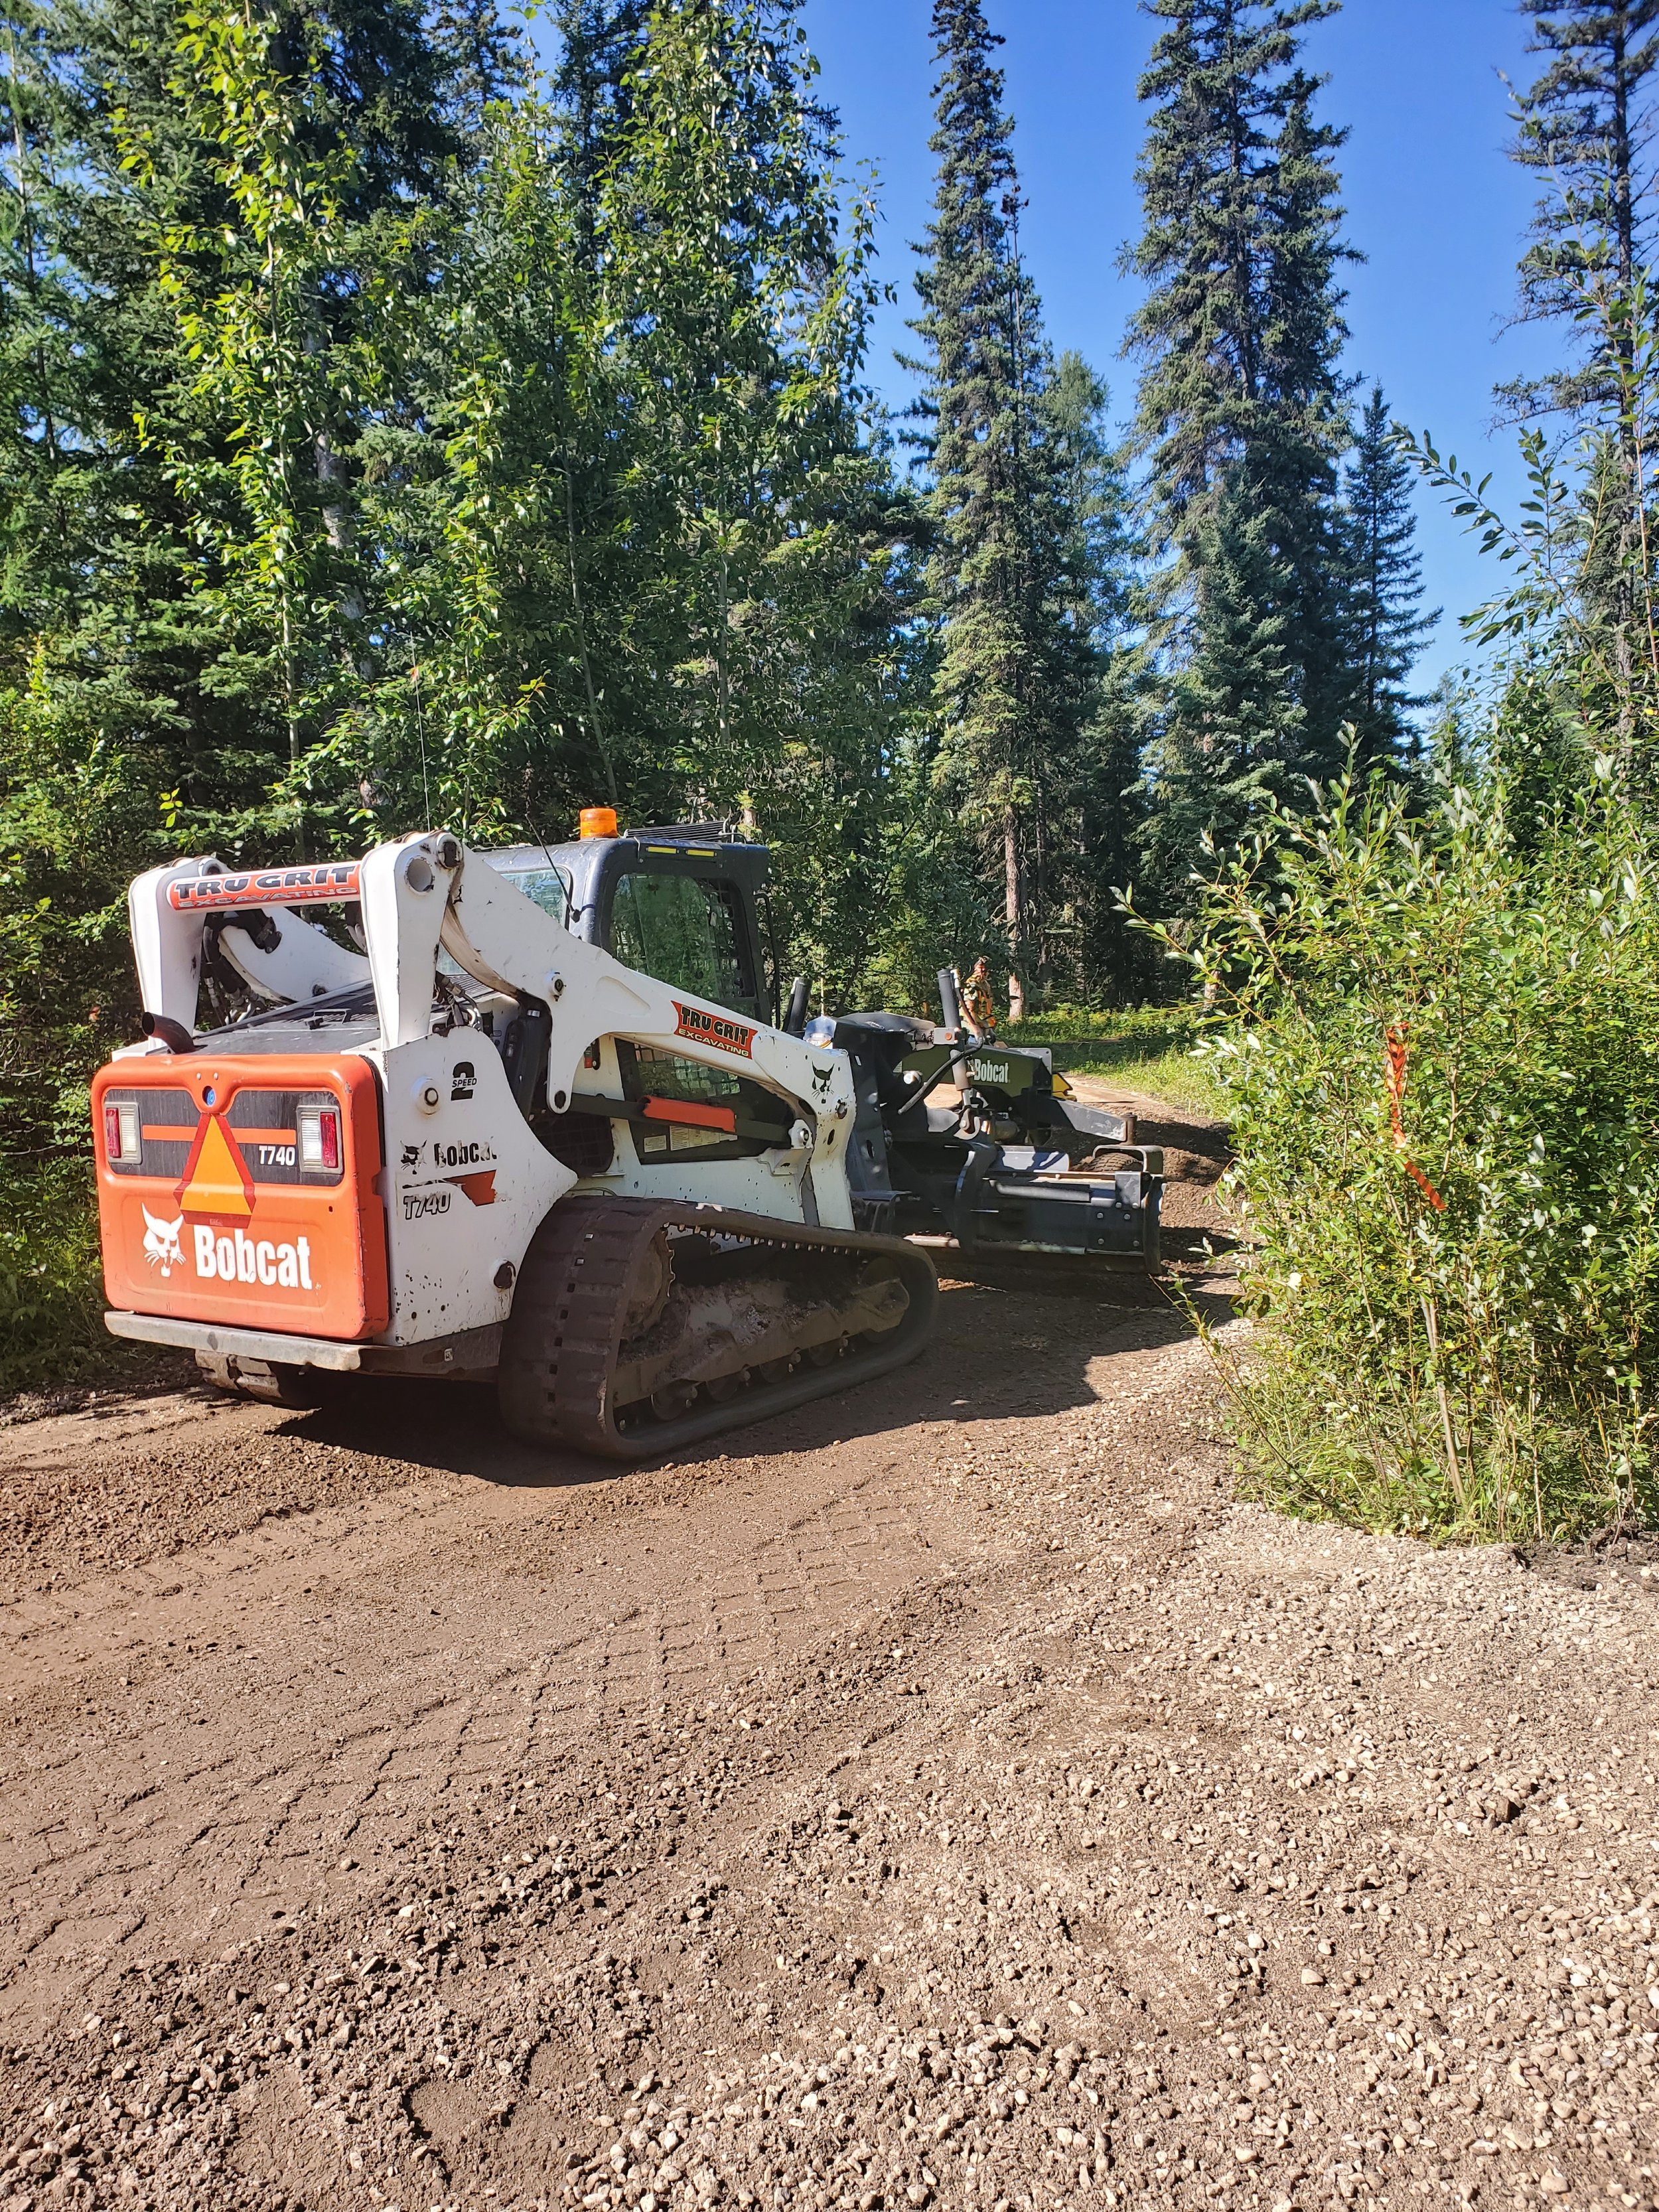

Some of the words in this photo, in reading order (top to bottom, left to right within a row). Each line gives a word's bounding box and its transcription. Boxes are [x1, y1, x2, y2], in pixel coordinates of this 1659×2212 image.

[175, 876, 250, 899] TRU
[255, 865, 356, 890] GRIT
[177, 887, 358, 908] EXCAVATING
[681, 1005, 712, 1031] TRU
[713, 1020, 749, 1047] GRIT
[678, 1028, 749, 1057] EXCAVATING
[451, 1062, 475, 1100] 2
[451, 1078, 477, 1088] SPEED
[974, 1059, 1009, 1083] Bobcat
[259, 1145, 295, 1166] T740
[403, 1192, 451, 1220] T740
[193, 1224, 312, 1290] Bobcat
